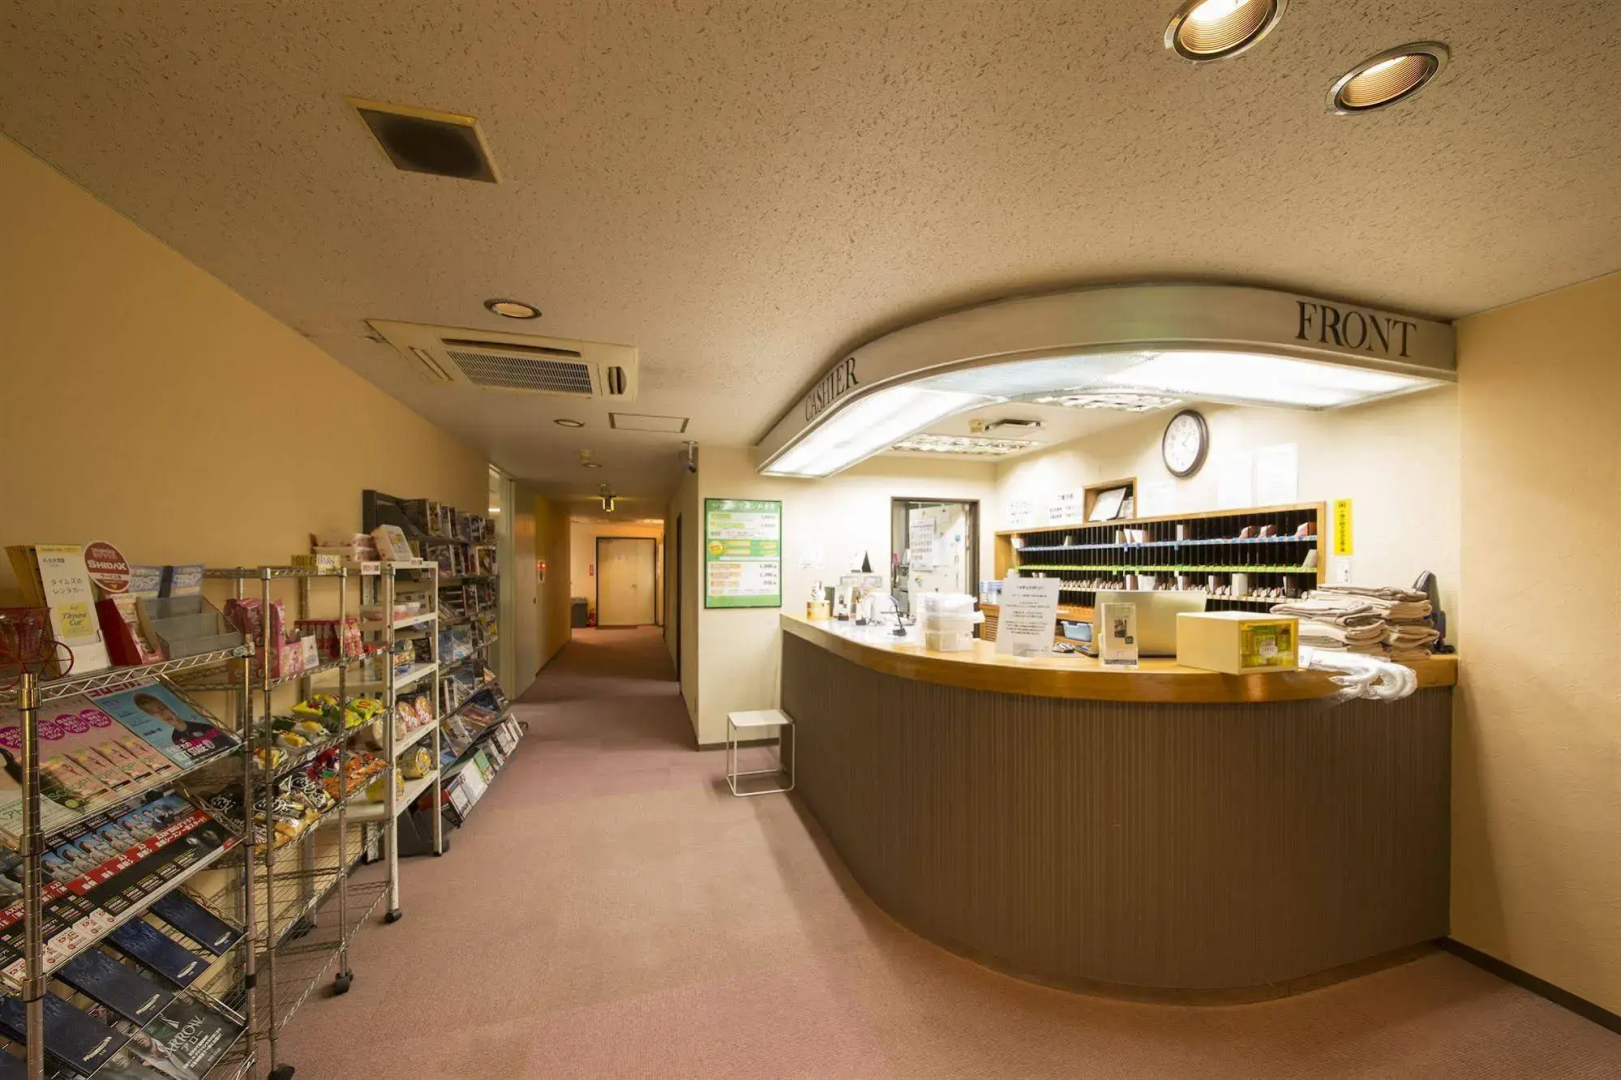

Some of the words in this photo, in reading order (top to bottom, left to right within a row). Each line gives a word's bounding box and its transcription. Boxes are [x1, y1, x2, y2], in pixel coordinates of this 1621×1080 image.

[1294, 300, 1417, 358] FRONT
[804, 356, 860, 422] CASHIER
[87, 558, 128, 571] SHIDAX
[50, 577, 83, 587] タイムズの
[52, 587, 84, 596] レンタカー
[61, 611, 87, 621] Times
[164, 1013, 207, 1058] ARROW
